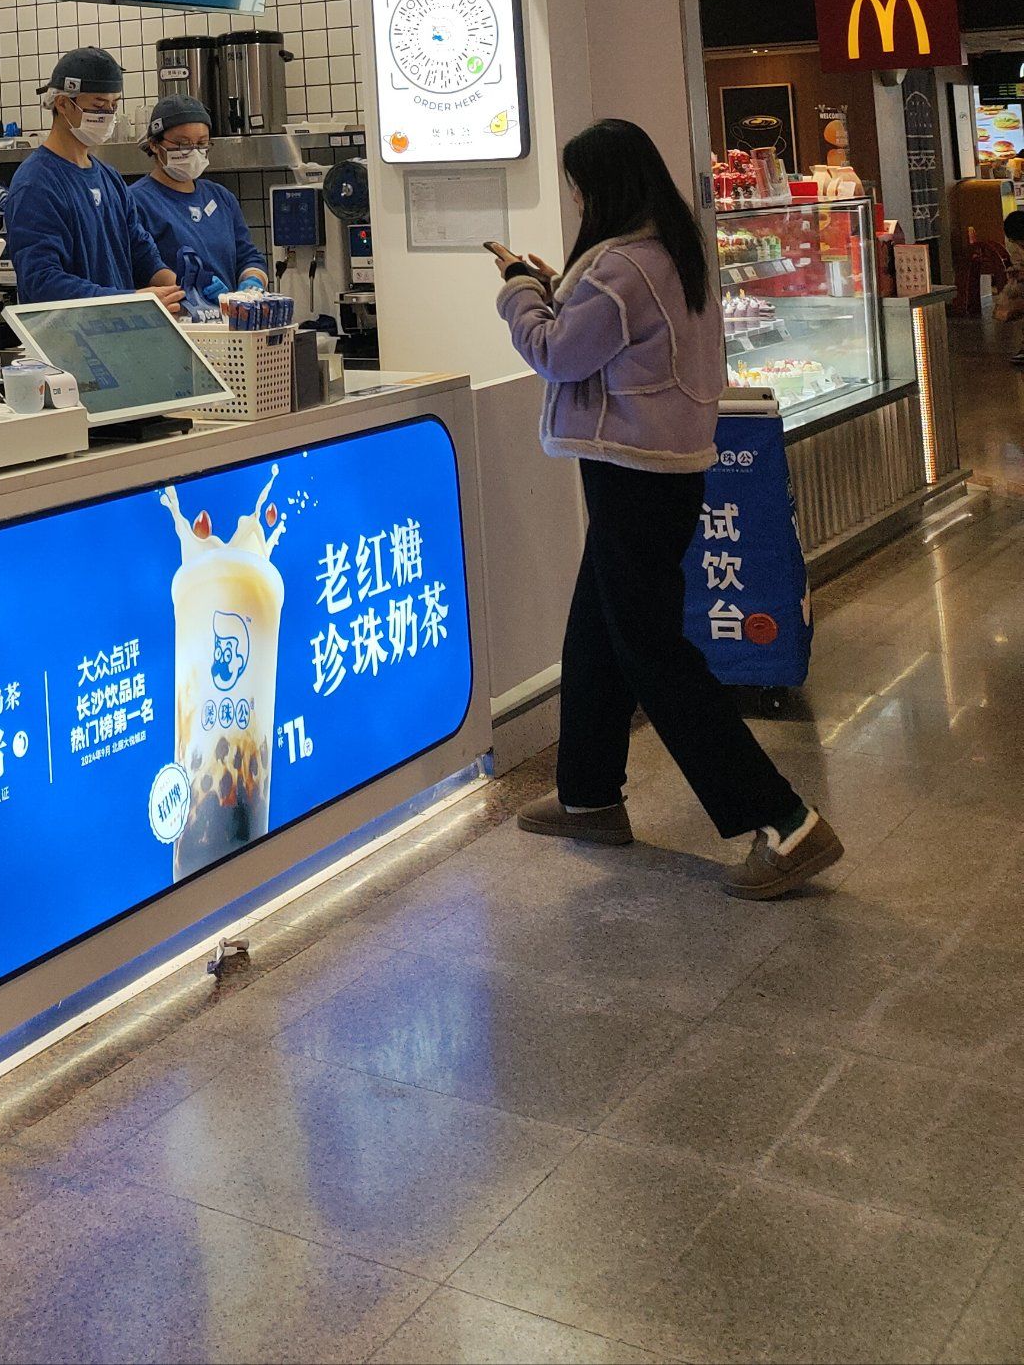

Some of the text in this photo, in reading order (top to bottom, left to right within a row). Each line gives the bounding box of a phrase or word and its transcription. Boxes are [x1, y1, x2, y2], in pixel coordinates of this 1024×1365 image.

[413, 90, 483, 111] ORDER HERE
[316, 518, 424, 615] 老红糖
[699, 502, 745, 640] 试饮台
[77, 638, 140, 687] 大众点评
[310, 580, 450, 697] 珍珠奶茶
[76, 673, 146, 721] 长沙饮品店
[203, 700, 250, 730] 煲珠公
[70, 698, 154, 754] 热门榜第一名
